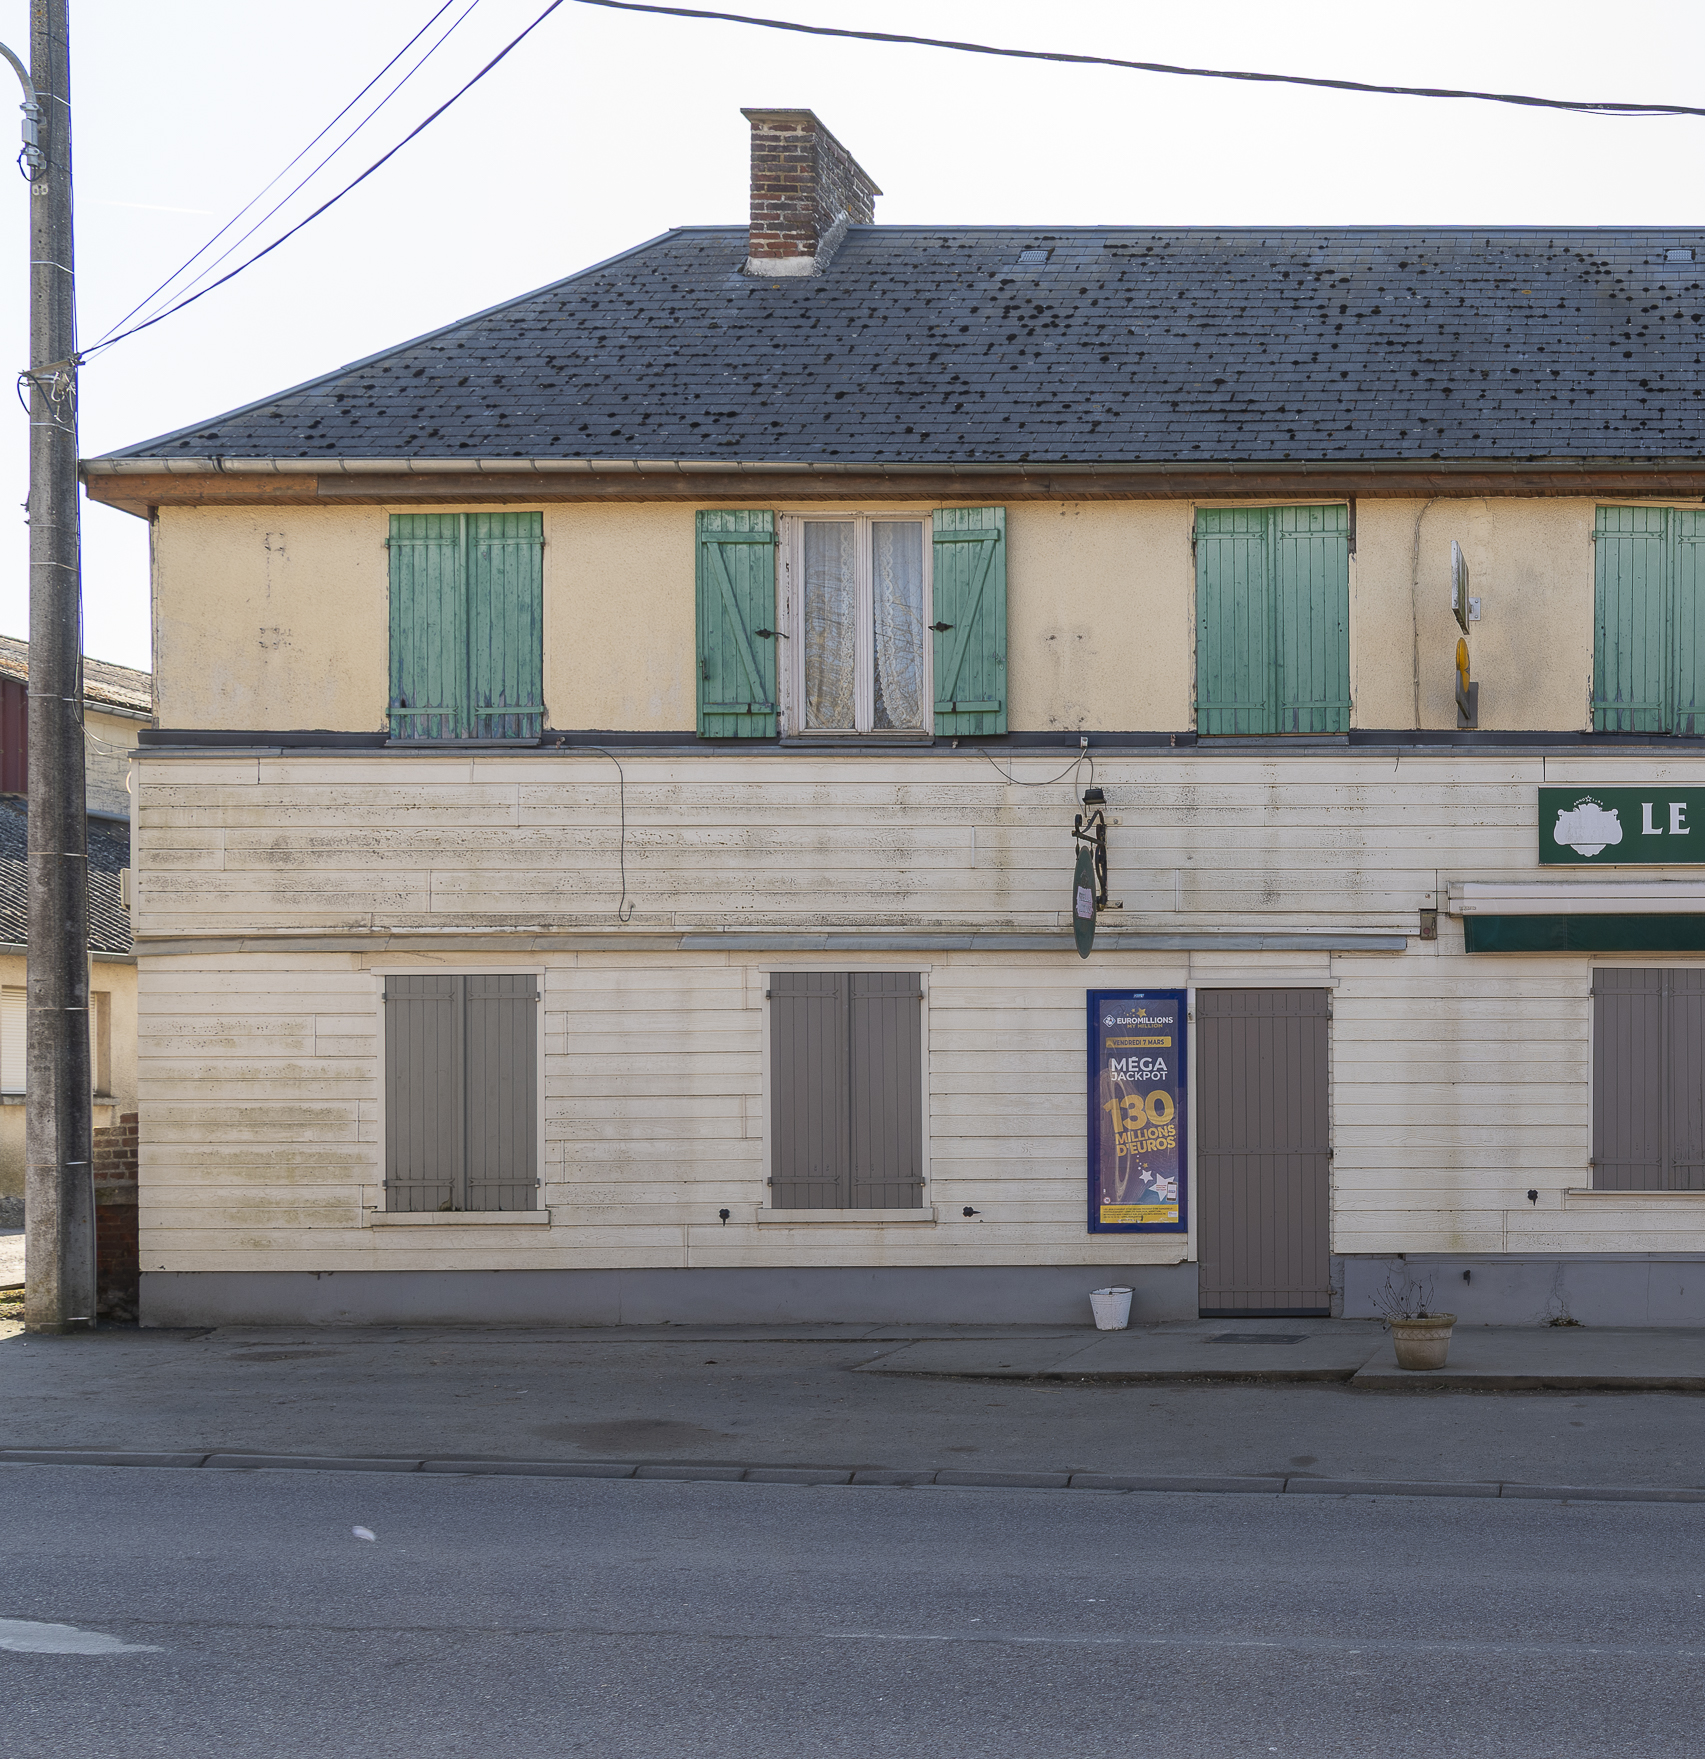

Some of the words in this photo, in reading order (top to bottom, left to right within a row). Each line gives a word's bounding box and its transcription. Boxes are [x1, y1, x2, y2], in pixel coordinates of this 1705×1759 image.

[1641, 802, 1691, 835] LE
[1116, 1016, 1174, 1025] EUROMILLIONS
[1111, 1056, 1168, 1072] MÉGA
[1111, 1071, 1168, 1081] JACKPOT
[1103, 1089, 1175, 1133] 130
[1115, 1124, 1176, 1145] MILLIONS
